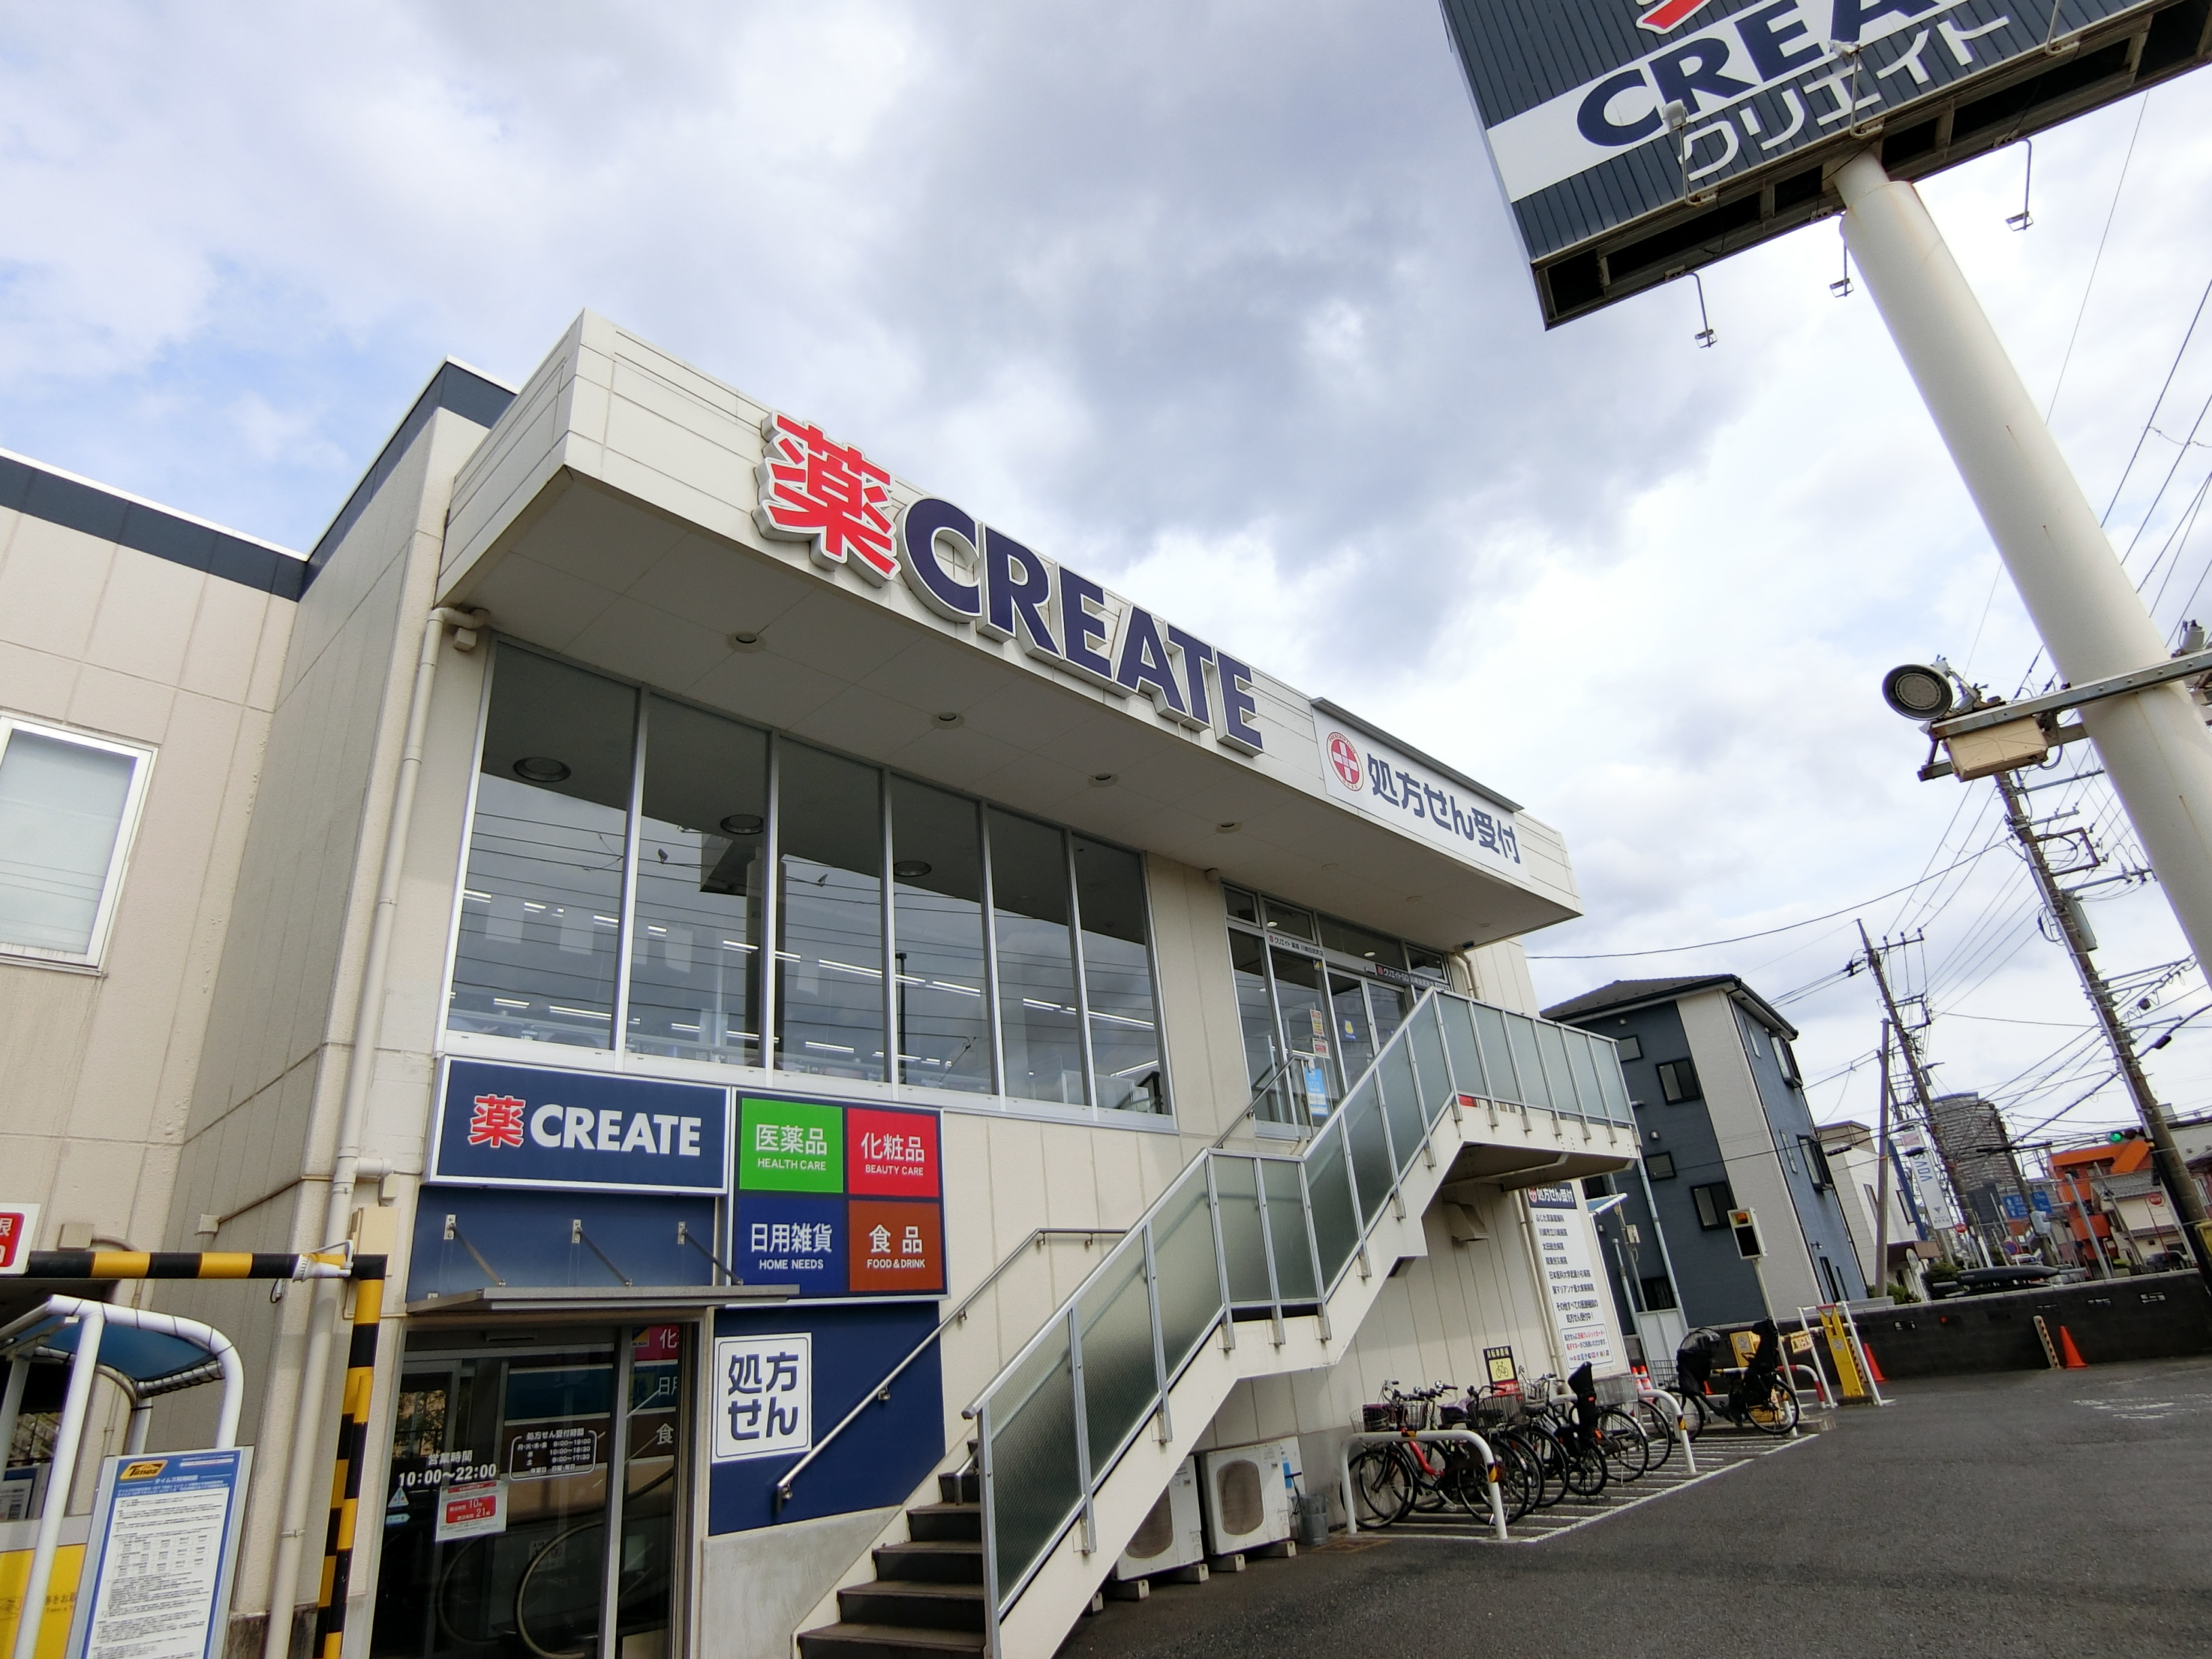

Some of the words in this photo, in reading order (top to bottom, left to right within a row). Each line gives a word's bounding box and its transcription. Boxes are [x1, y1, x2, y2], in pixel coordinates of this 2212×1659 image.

[1678, 15, 2010, 182] クリエイト
[758, 411, 901, 581] 薬
[900, 497, 1263, 754] CREATE
[1367, 752, 1521, 865] 処方せん受付
[468, 1093, 526, 1148] 薬
[531, 1103, 702, 1156] CREATE
[756, 1124, 827, 1155] 医薬品
[861, 1132, 925, 1162] 化粧品
[758, 1158, 798, 1170] HEALTH
[800, 1160, 827, 1171] CARE
[865, 1164, 900, 1175] BEAUTY
[901, 1166, 924, 1176] CARE
[751, 1223, 833, 1254] 日用雑貨
[759, 1259, 789, 1270] HOME
[792, 1258, 824, 1269] NEEDS
[660, 1328, 679, 1349] 化
[728, 1351, 799, 1396] 処方
[728, 1396, 798, 1441] せん
[129, 1464, 161, 1477] Times
[428, 1450, 473, 1466] 営業時間
